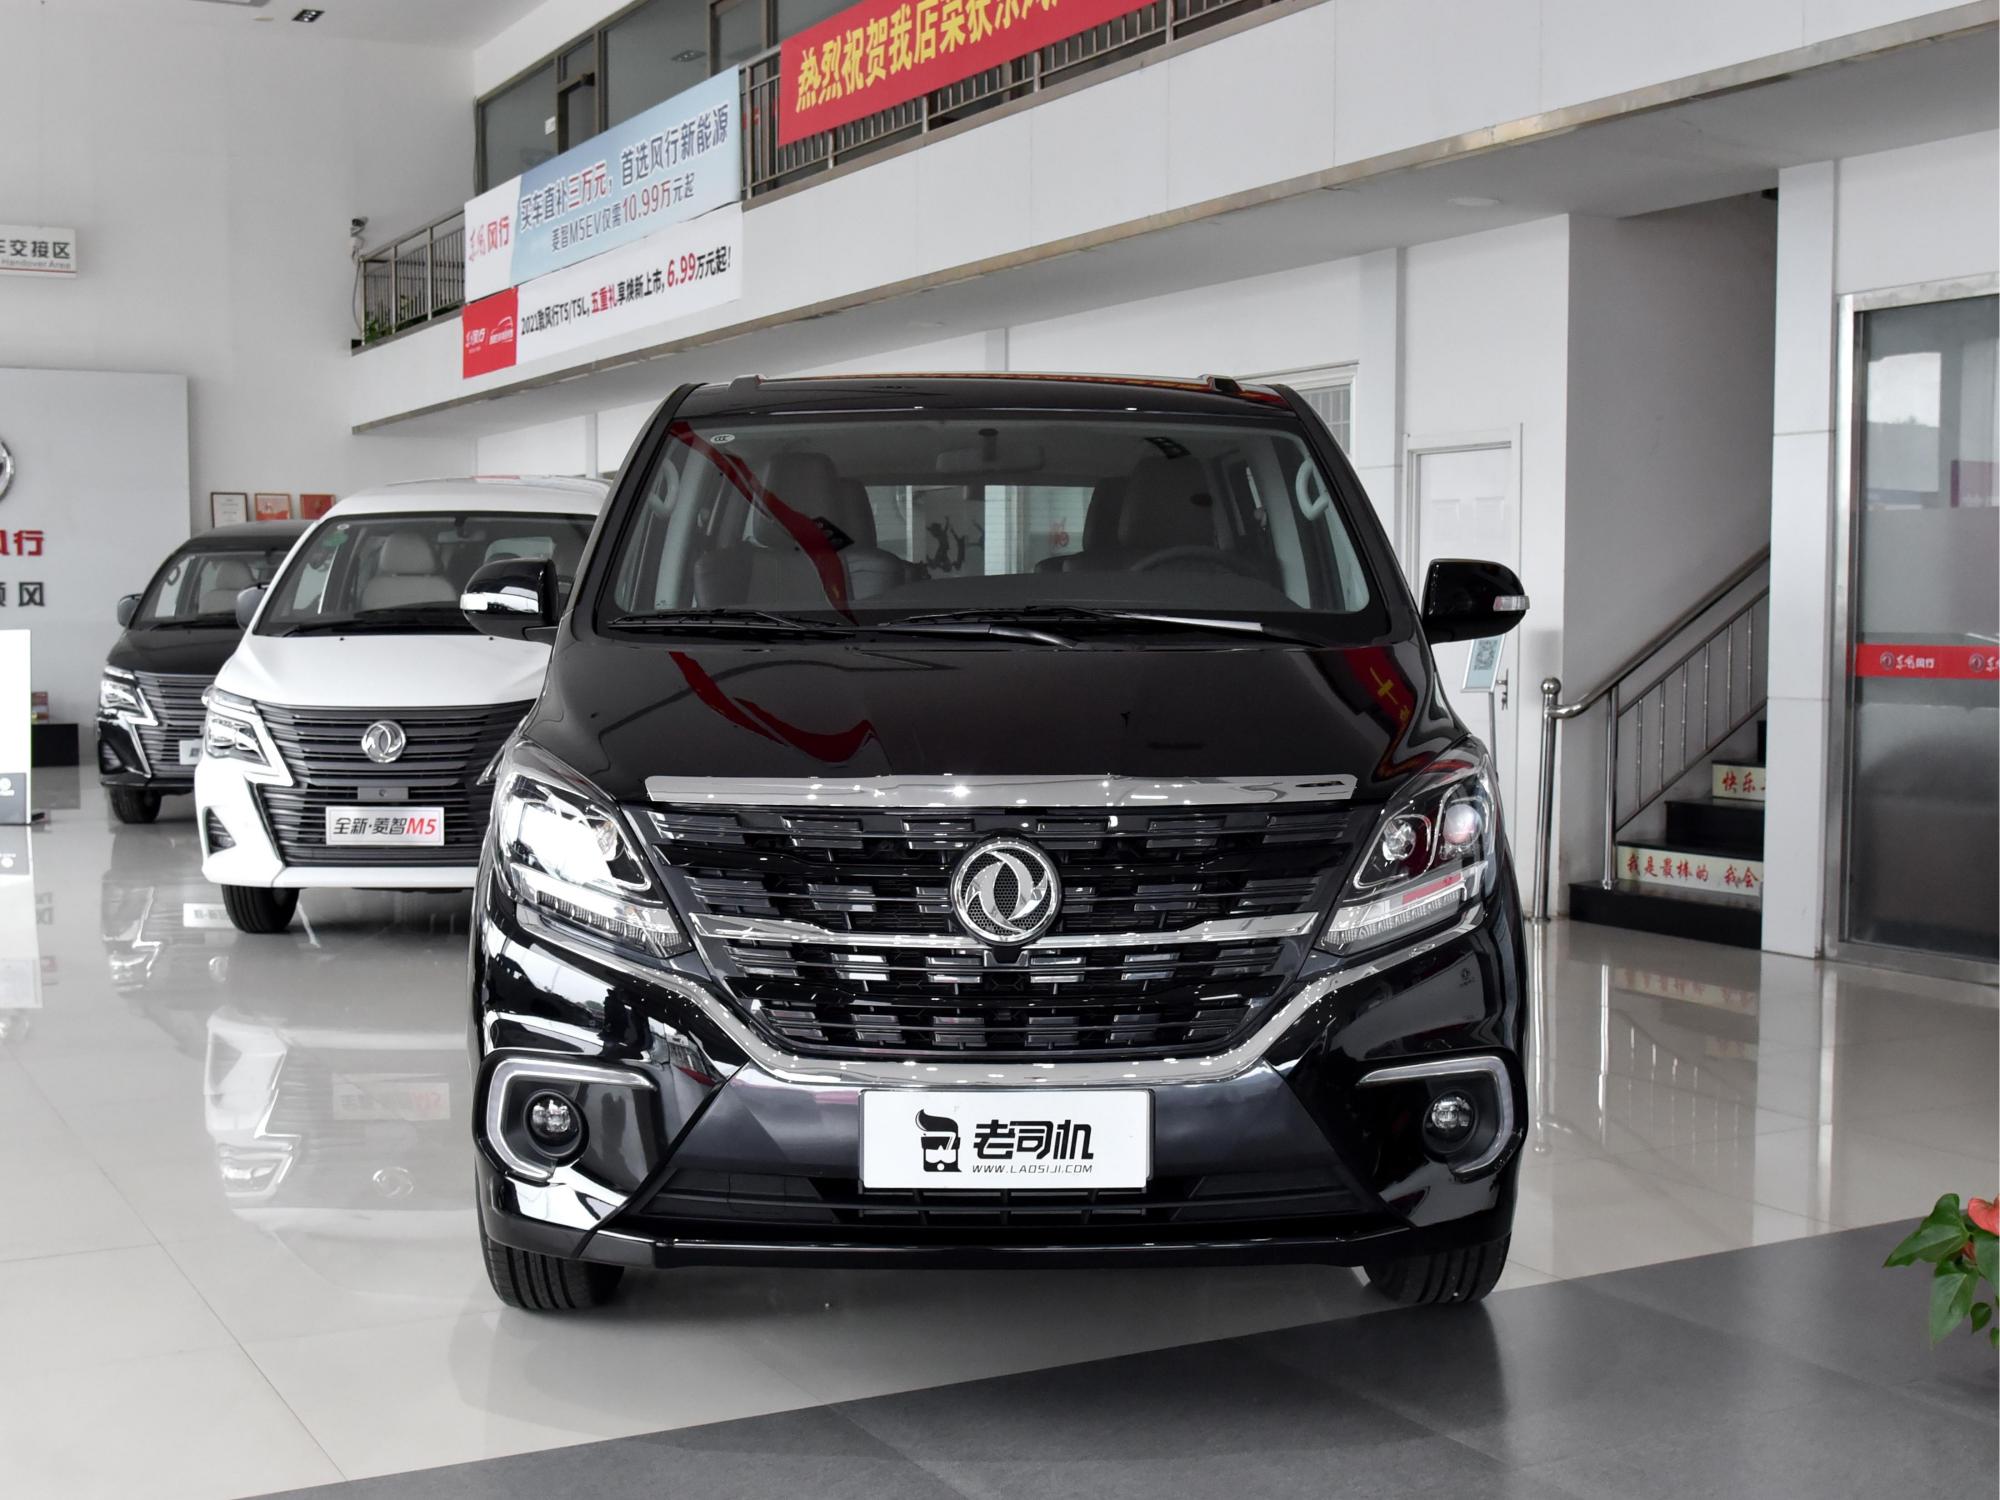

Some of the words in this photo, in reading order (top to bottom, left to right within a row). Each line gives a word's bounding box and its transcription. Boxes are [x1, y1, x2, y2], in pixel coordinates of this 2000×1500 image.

[973, 1119, 1094, 1160] 老司机
[972, 1164, 1093, 1174] WWW.LAOSIJI.COM
